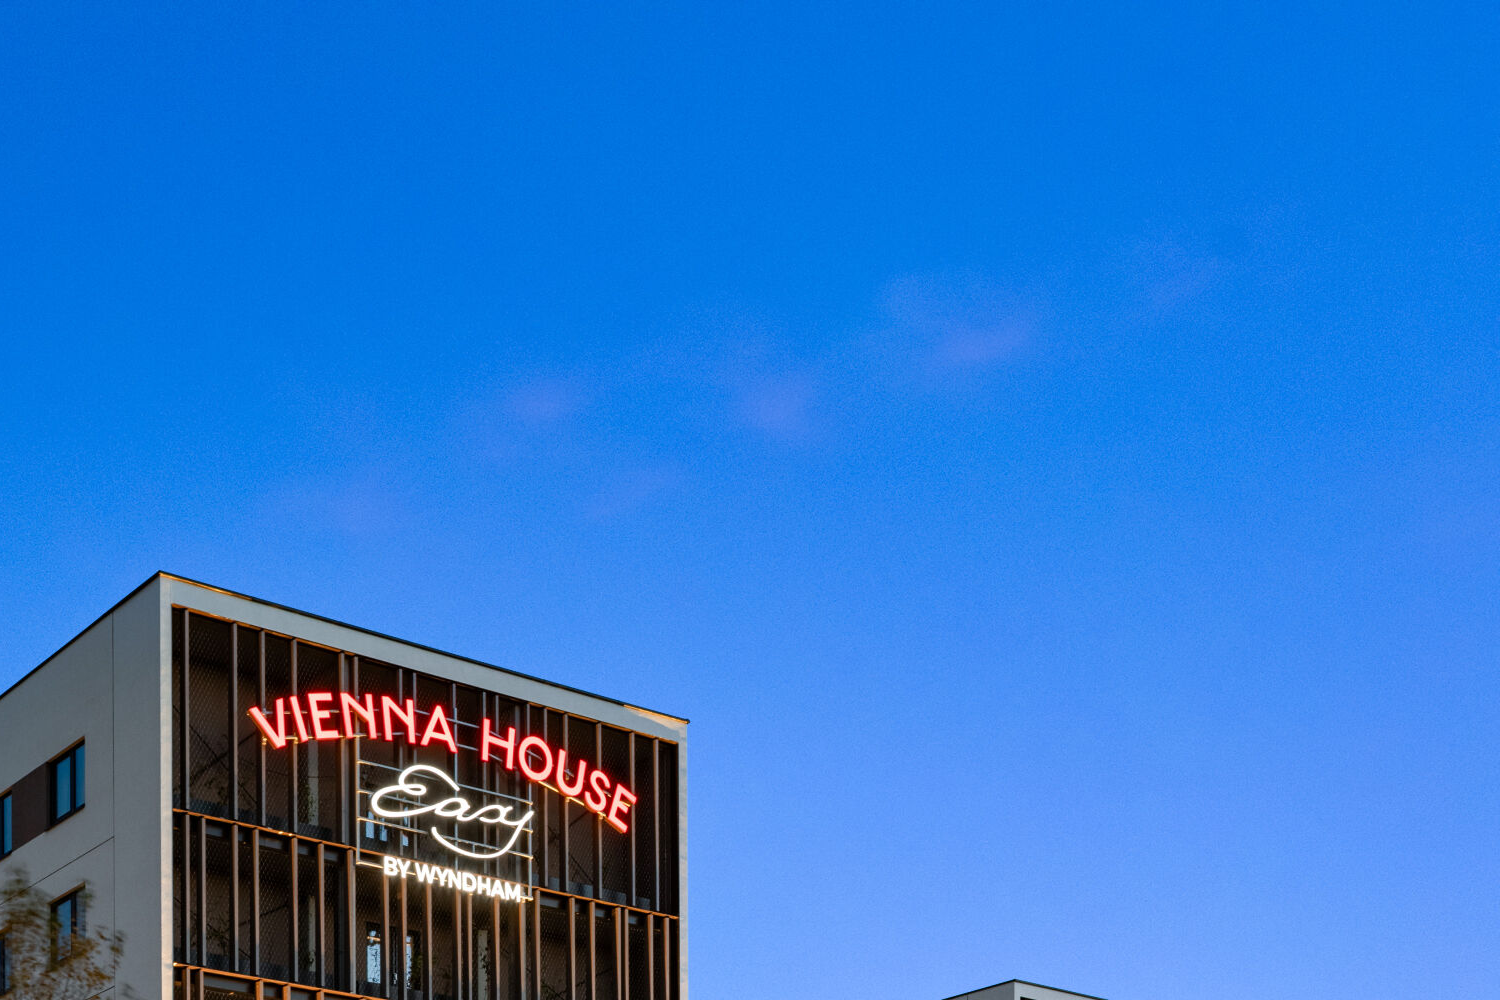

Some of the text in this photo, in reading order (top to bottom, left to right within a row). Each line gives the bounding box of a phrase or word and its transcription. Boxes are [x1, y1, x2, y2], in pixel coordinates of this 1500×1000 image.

[248, 692, 637, 833] VIENNA HOUSE
[370, 764, 534, 858] Easy
[383, 855, 522, 902] BY WYNDHAM
